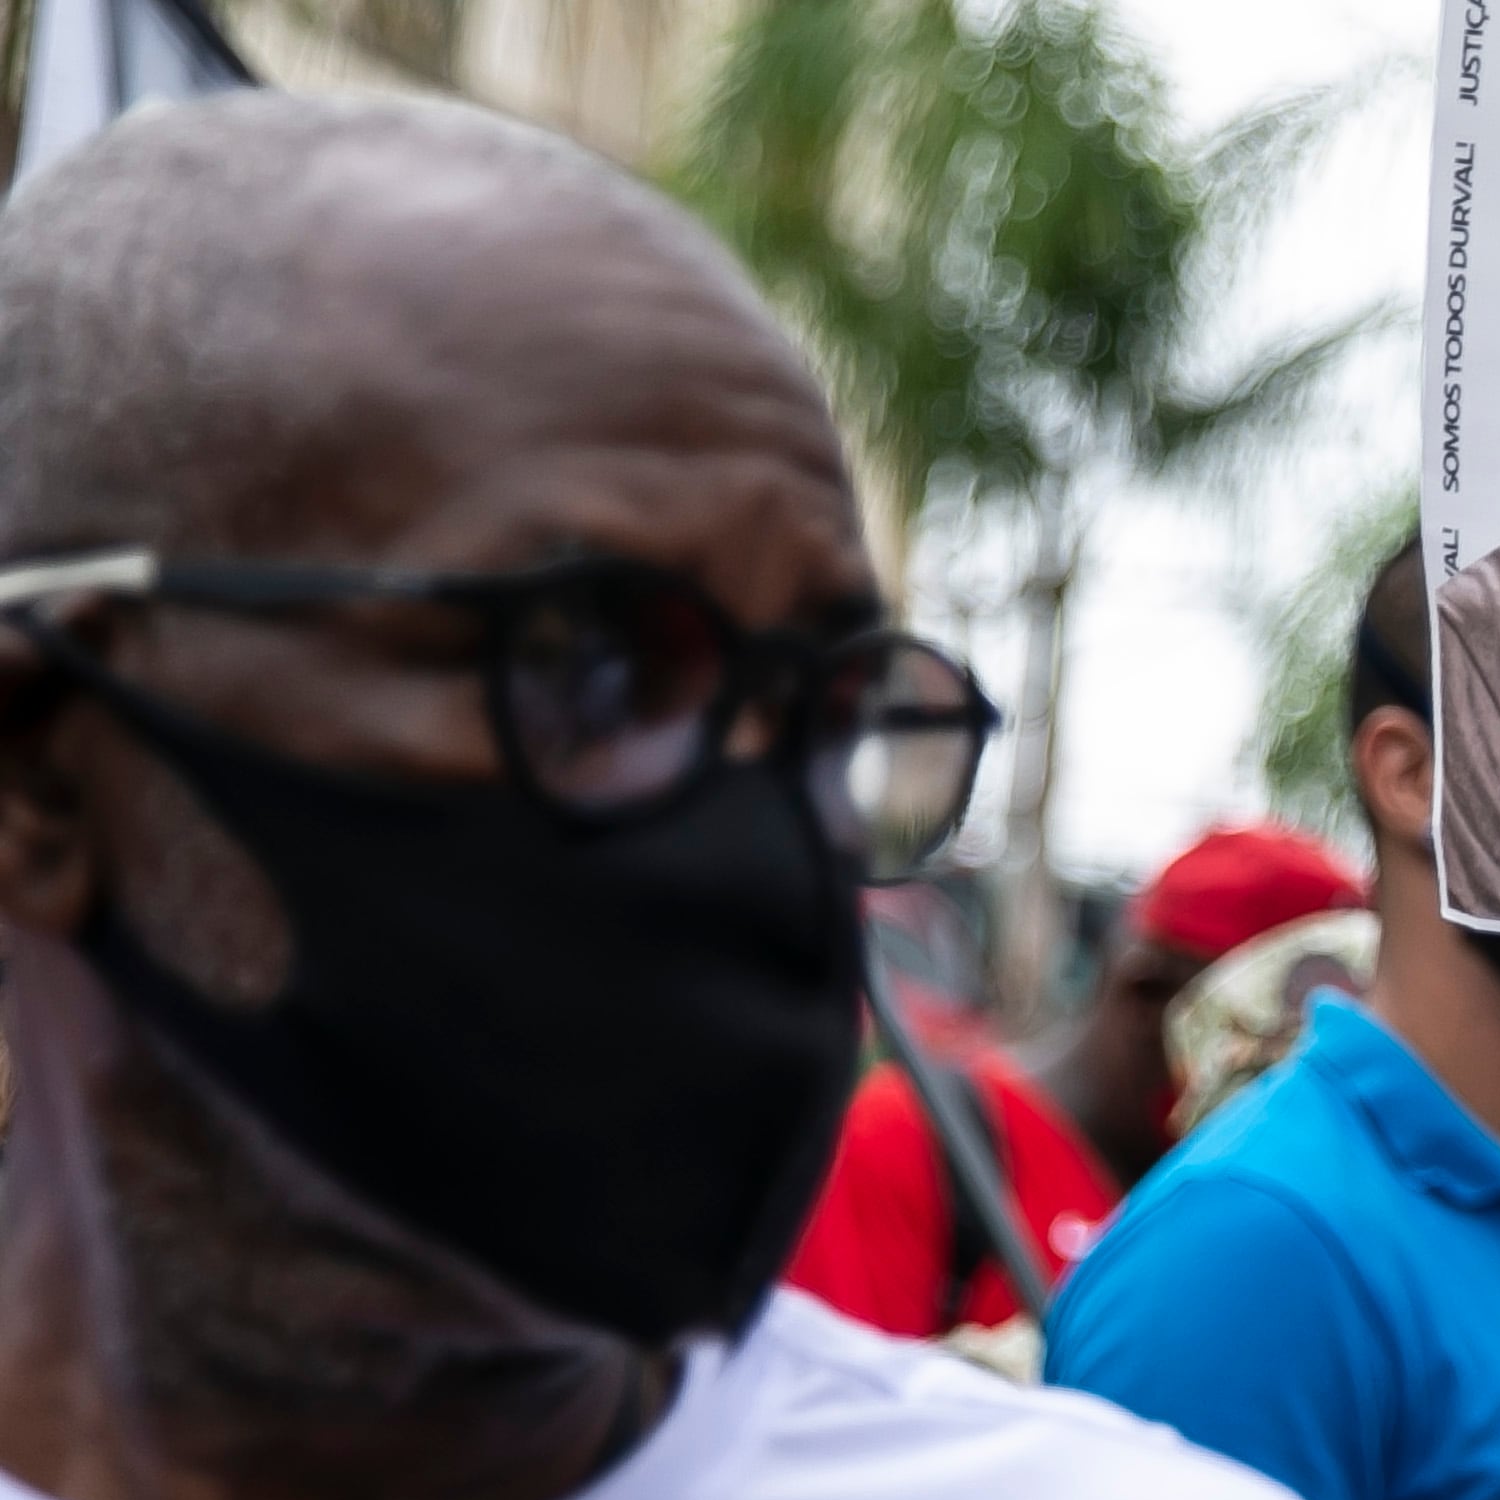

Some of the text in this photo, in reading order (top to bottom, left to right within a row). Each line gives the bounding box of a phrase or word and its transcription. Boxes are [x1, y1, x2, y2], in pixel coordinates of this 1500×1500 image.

[1442, 141, 1475, 493] SOMOS TODOS DURVAL!
